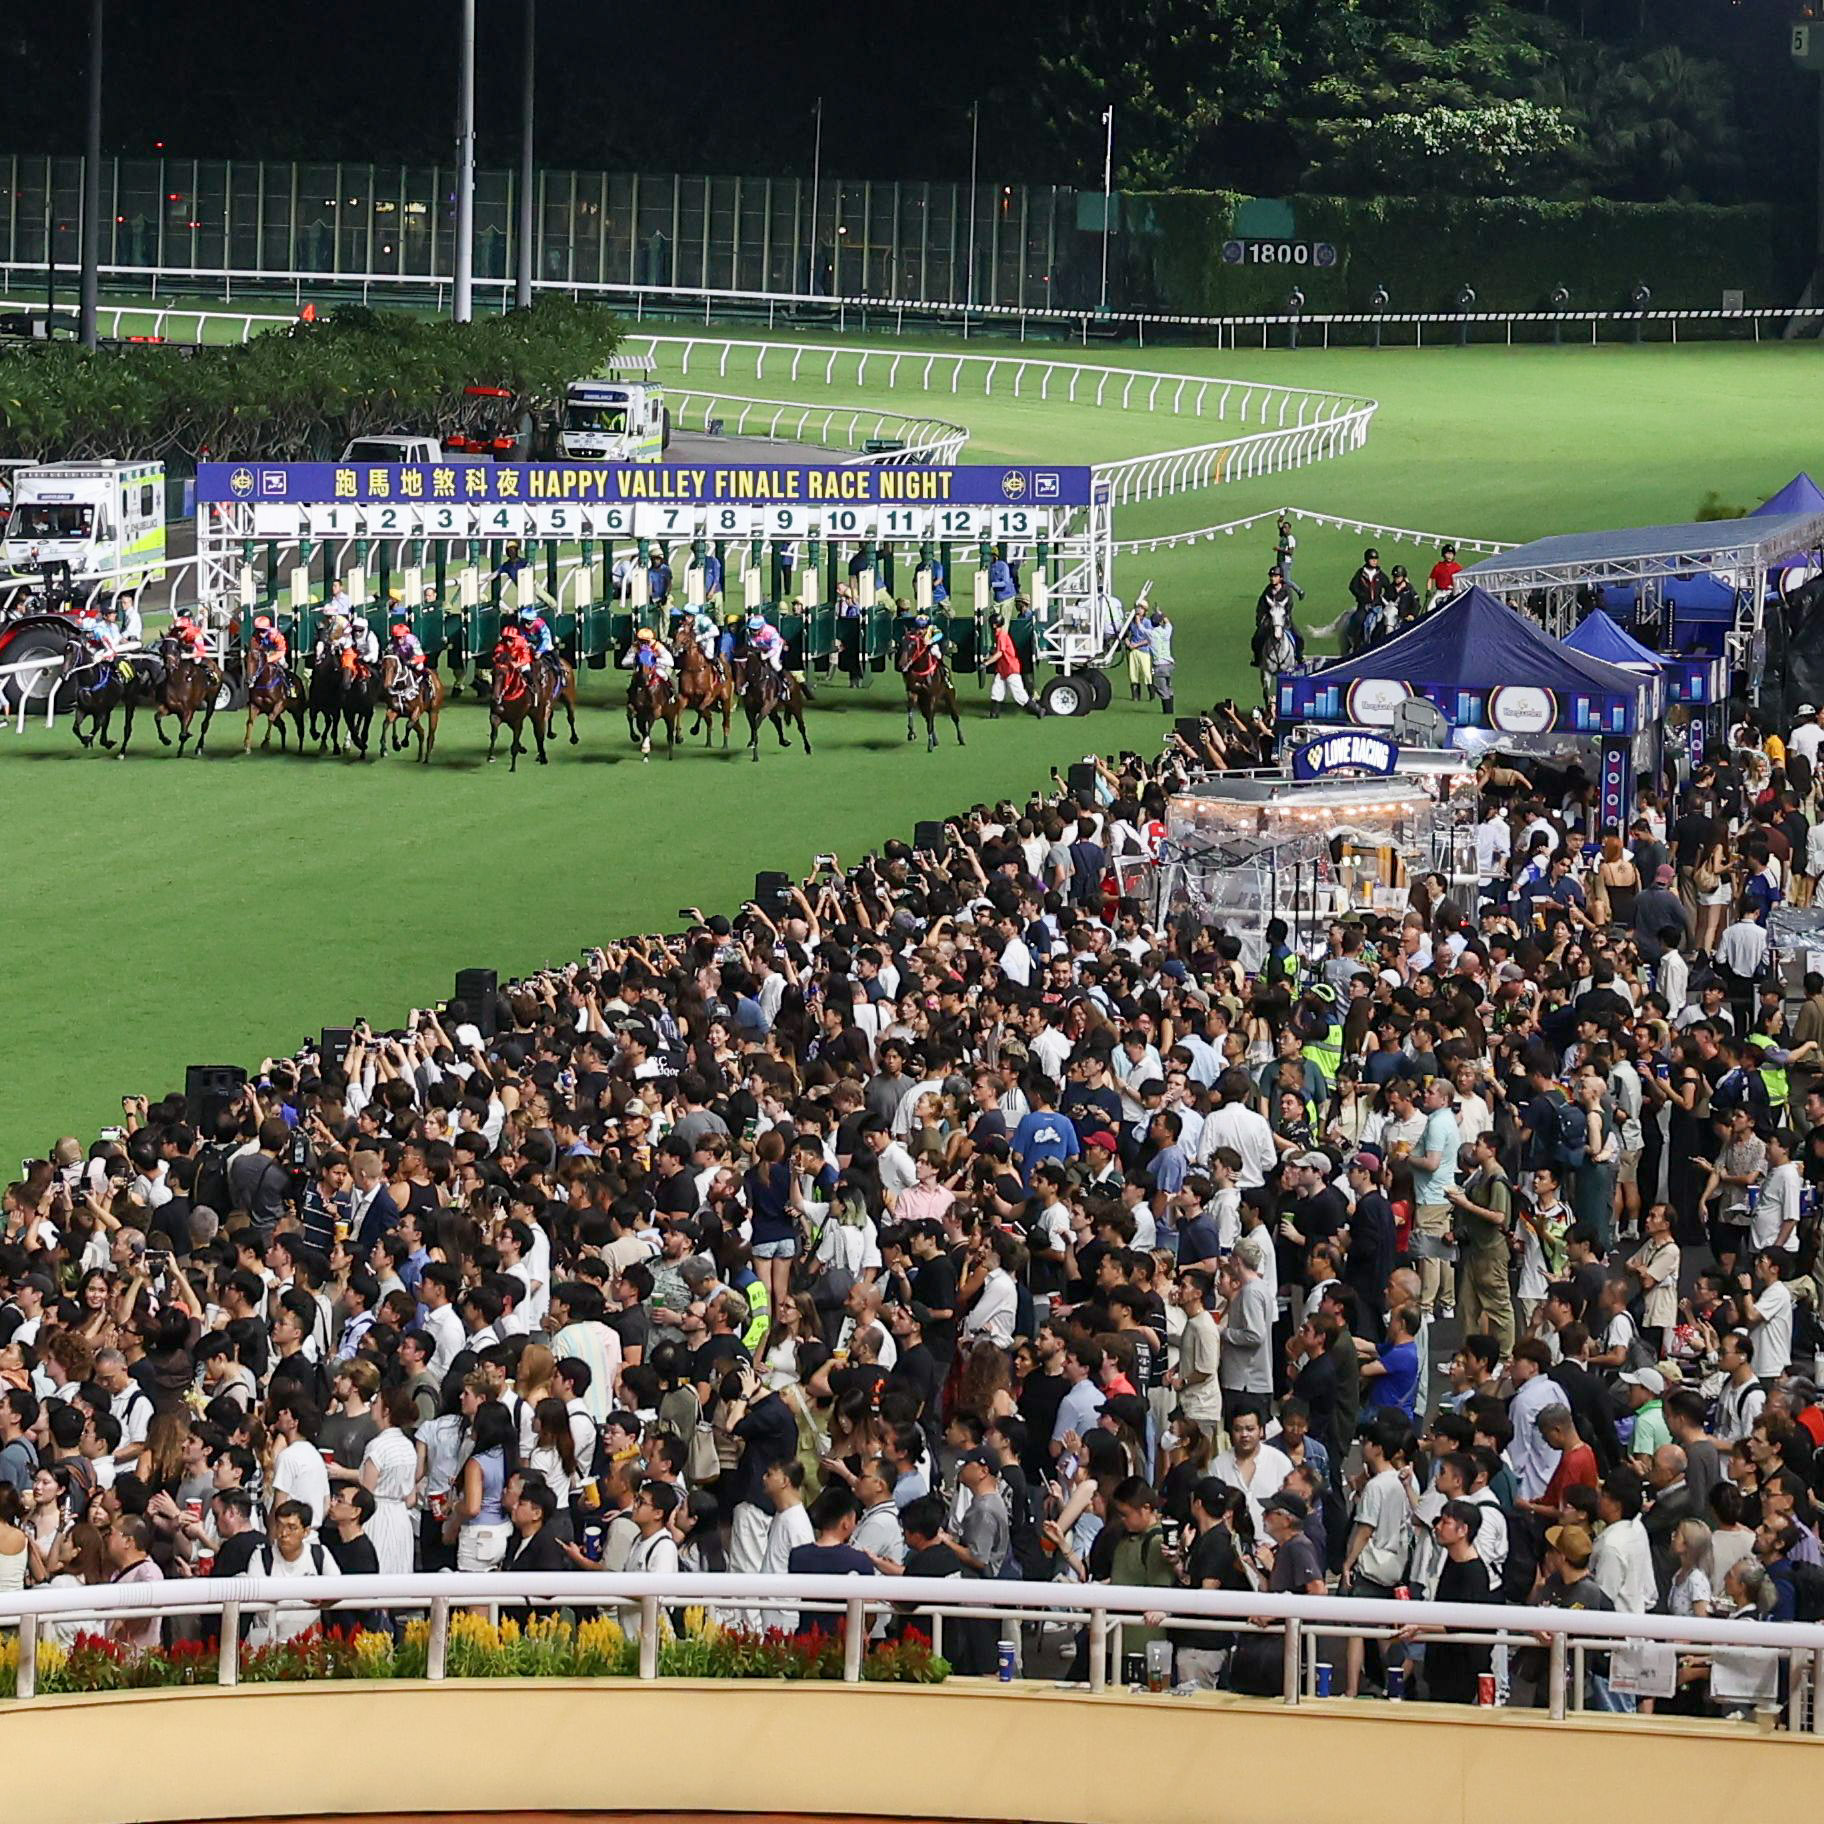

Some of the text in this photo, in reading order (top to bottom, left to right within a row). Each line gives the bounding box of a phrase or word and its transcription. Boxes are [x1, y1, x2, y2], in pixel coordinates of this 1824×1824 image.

[1249, 243, 1308, 264] 1800
[335, 468, 952, 499] 跑馬地煞科夜 HAPPY VALLEY FINALE RACE NIGHT
[327, 508, 1027, 532] 1 2 3 4 5 6 7 8 9 10 11 12 13
[1325, 736, 1389, 771] LOVE RACING
